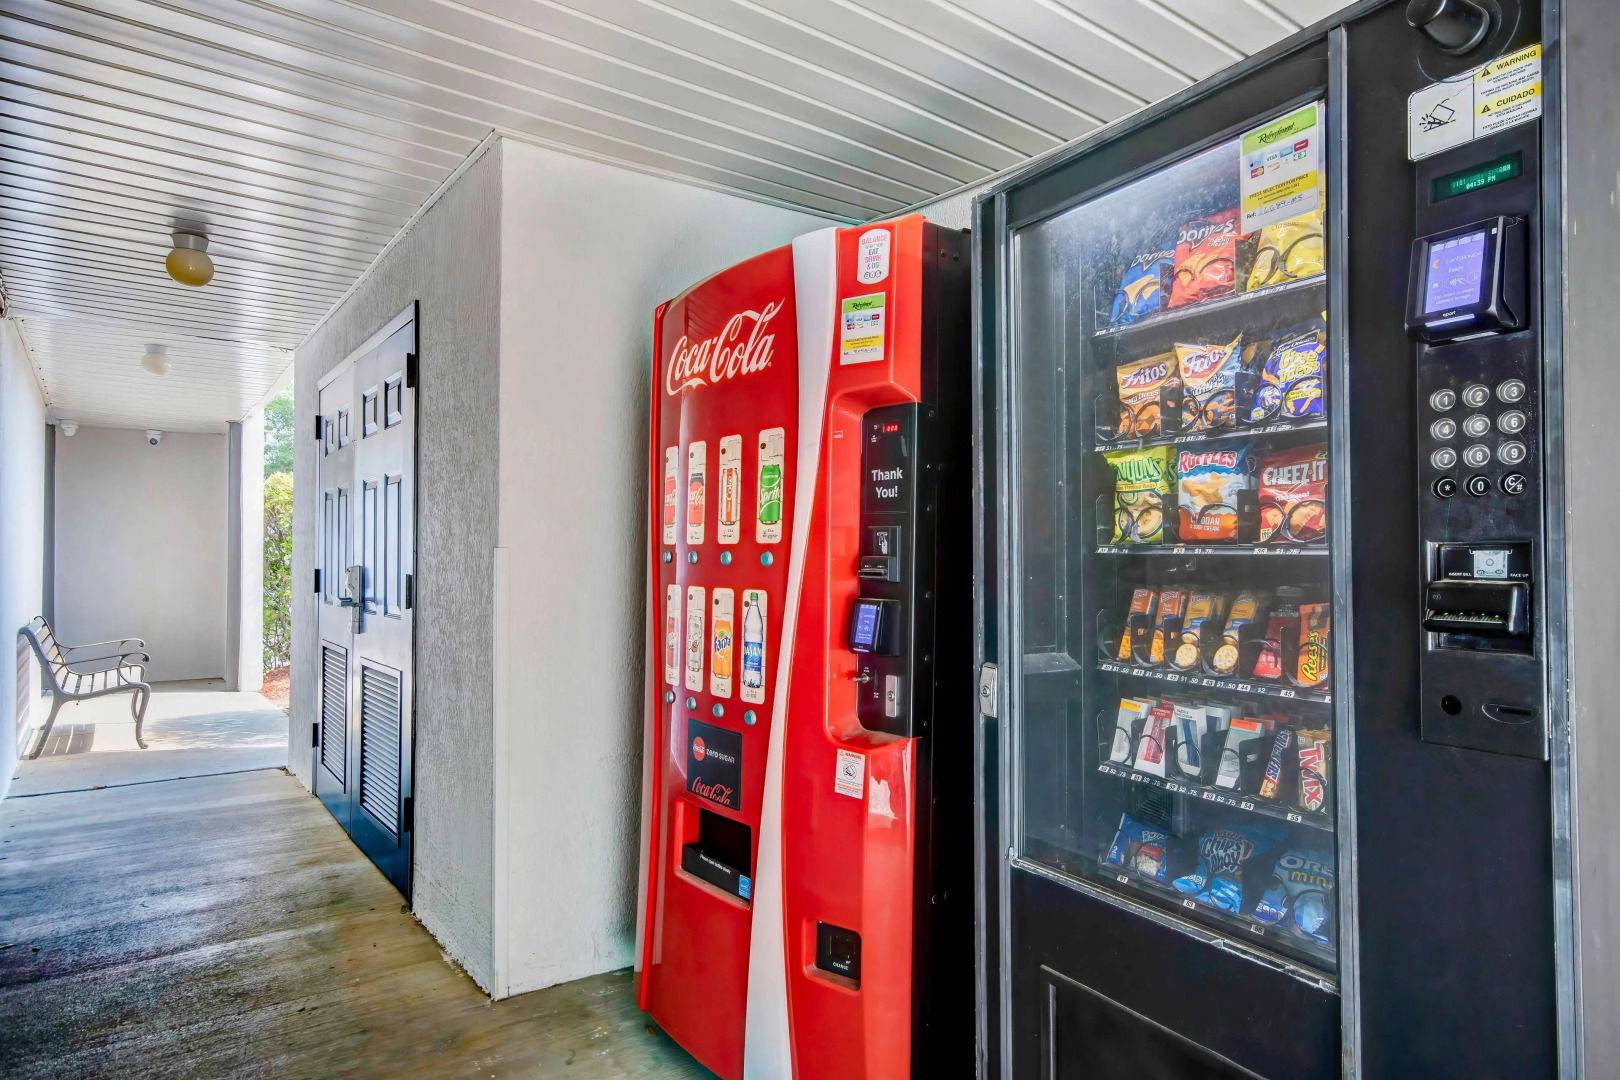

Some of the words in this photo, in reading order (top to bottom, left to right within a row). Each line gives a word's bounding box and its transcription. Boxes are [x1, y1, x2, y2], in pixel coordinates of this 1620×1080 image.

[1496, 49, 1536, 71] WARNING
[1496, 88, 1535, 107] CUIDADO
[1249, 189, 1262, 199] PRESS
[1262, 180, 1285, 194] SELECTION
[1286, 177, 1295, 185] FOR
[1295, 172, 1308, 182] PRICE
[1466, 179, 1485, 190] 04:39
[1488, 175, 1496, 183] PM
[1246, 210, 1256, 220] Ref:
[1177, 217, 1236, 245] Doritos
[861, 234, 888, 246] BALANCE
[868, 248, 879, 256] EAT
[865, 255, 882, 264] DRINK
[1130, 249, 1175, 268] Dorito
[872, 261, 880, 269] DO
[666, 296, 785, 396] Coca-Cola
[1182, 348, 1226, 379] Fritos
[1121, 363, 1167, 389] Fritos
[1476, 391, 1483, 402] 2
[1511, 386, 1518, 397] 3
[1442, 396, 1448, 405] 1
[1476, 421, 1483, 431] 5
[1511, 417, 1518, 428] 6
[1443, 424, 1450, 435] 4
[1443, 454, 1449, 464] 7
[1476, 451, 1483, 462] 8
[1511, 448, 1519, 459] 9
[1178, 451, 1237, 474] RUFFLES
[871, 467, 903, 481] Thank
[1116, 457, 1163, 485] NYUNS
[1478, 481, 1485, 492] 0
[760, 486, 781, 506] Sprit
[875, 486, 898, 499] You!
[1190, 516, 1220, 526] CDDAR
[1145, 671, 1163, 679] $1.50
[1180, 677, 1199, 686] $1.50
[1216, 682, 1236, 690] $1.50
[1283, 690, 1293, 698] 45
[1298, 741, 1325, 807] TWIX
[1143, 777, 1161, 787] $2.75
[691, 776, 734, 805] Coca-Cola
[1179, 788, 1198, 797] $2.75
[1217, 796, 1236, 806] $2.75
[1244, 802, 1252, 810] 54
[1290, 814, 1299, 822] 55
[1280, 855, 1334, 878] ORE
[1290, 870, 1333, 889] mini
[832, 961, 849, 971] CHANGE
